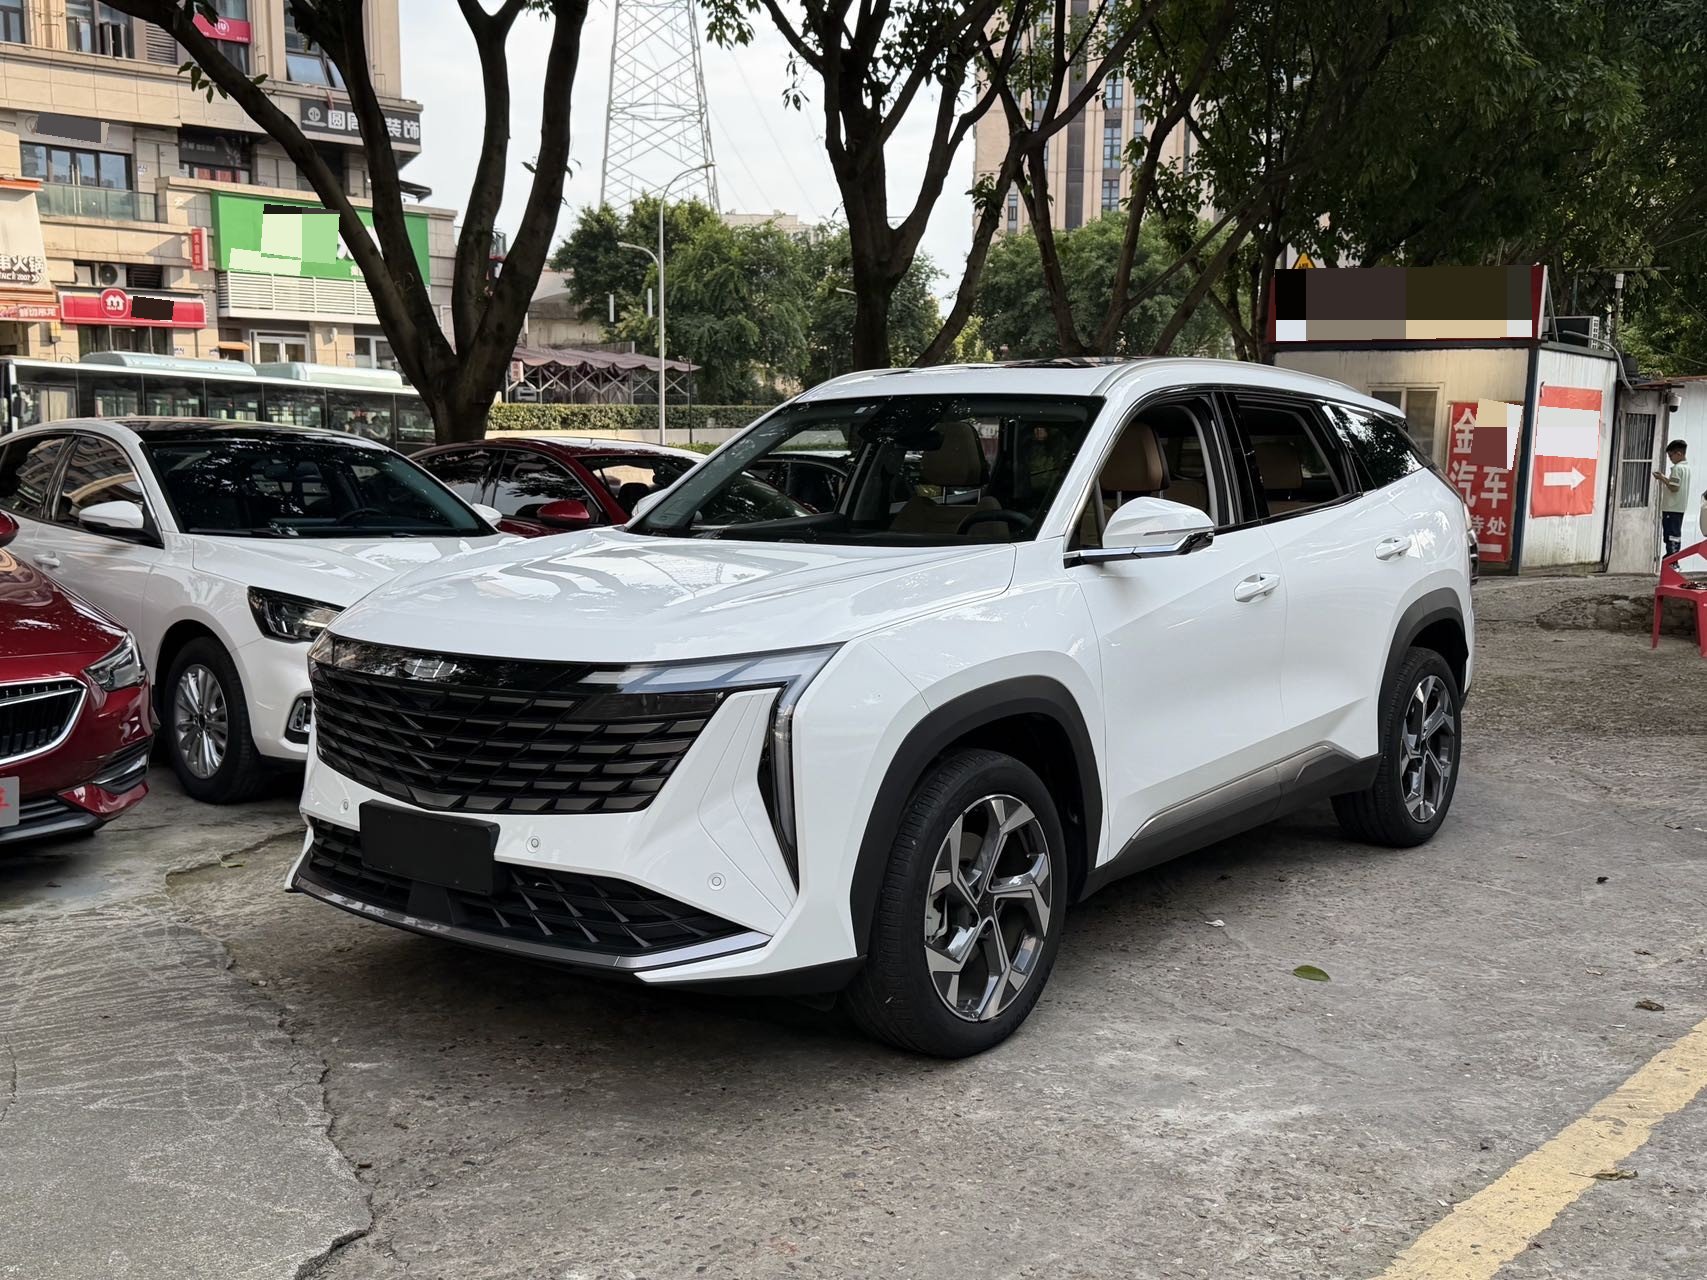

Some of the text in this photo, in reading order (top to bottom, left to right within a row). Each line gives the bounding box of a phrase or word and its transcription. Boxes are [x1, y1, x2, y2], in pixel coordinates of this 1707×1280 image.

[328, 110, 419, 139] 圆装饰
[1451, 460, 1508, 509] 汽车
[1471, 515, 1507, 536] 待处
